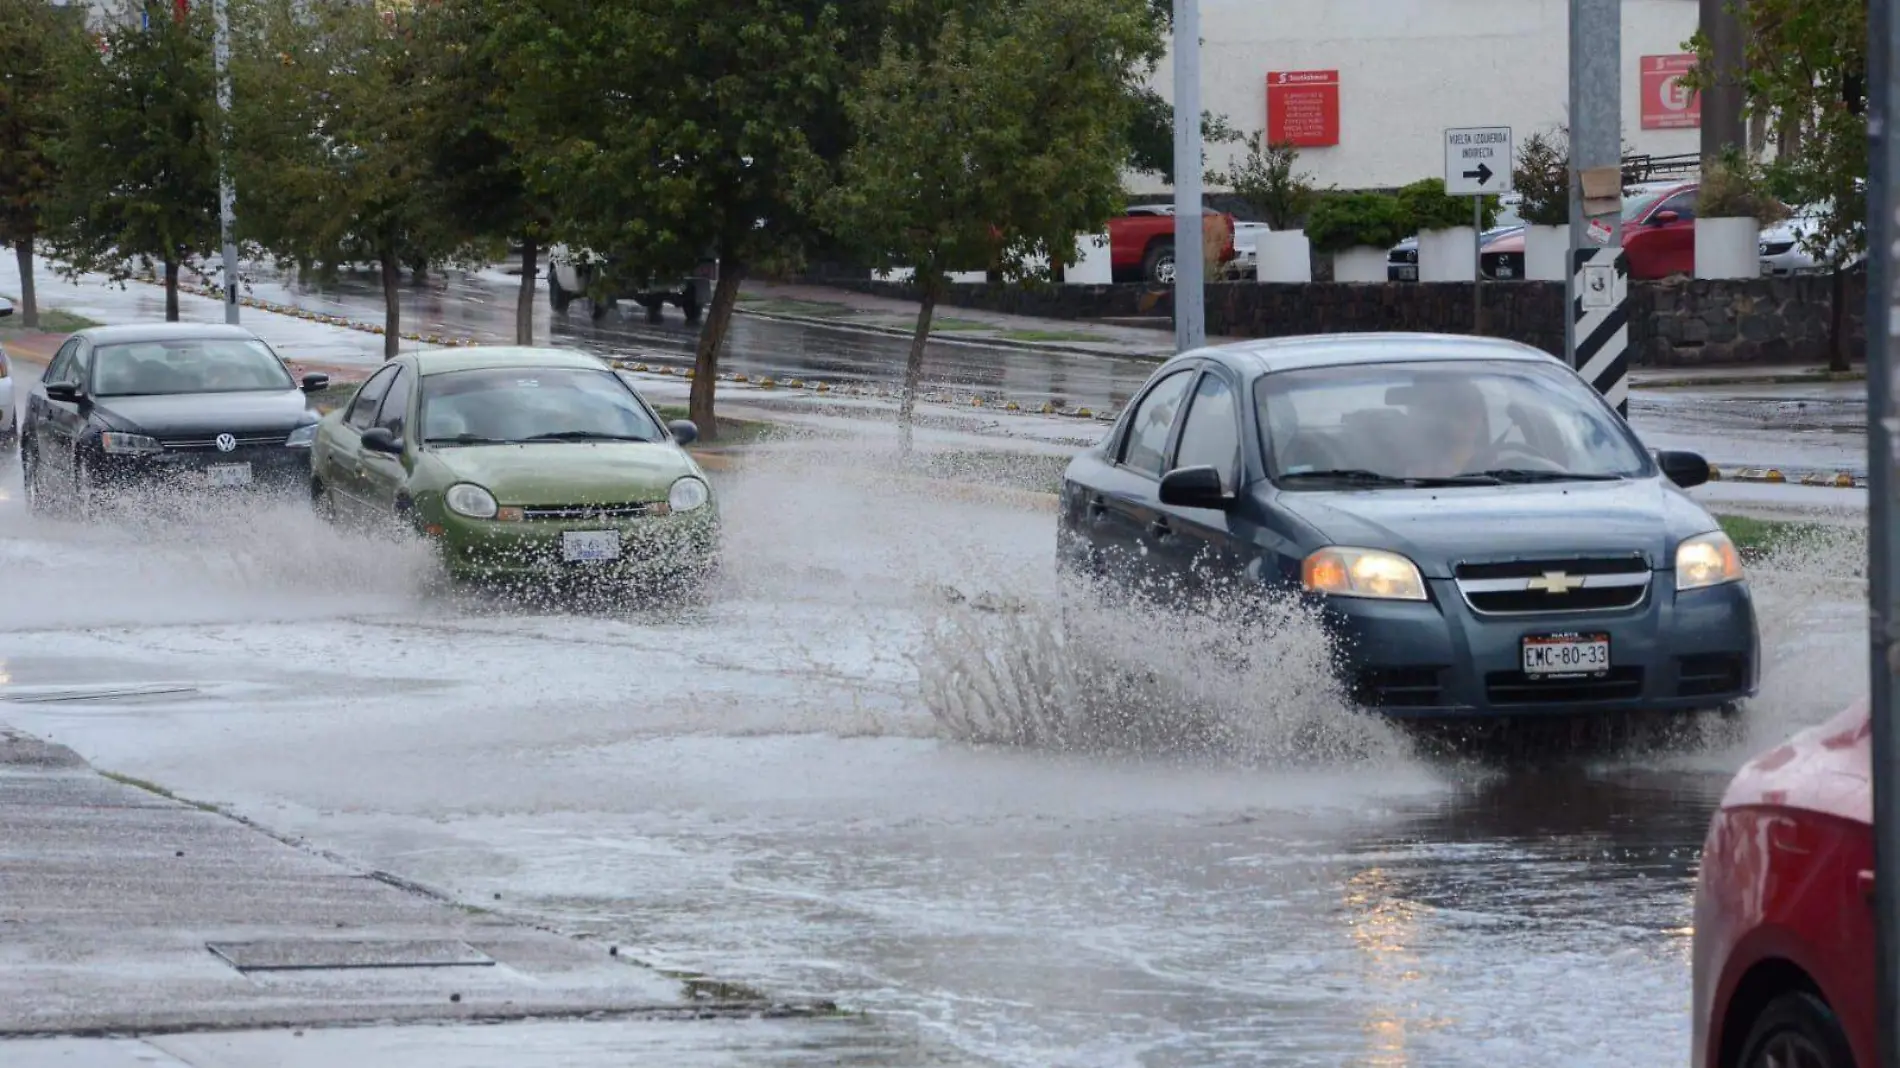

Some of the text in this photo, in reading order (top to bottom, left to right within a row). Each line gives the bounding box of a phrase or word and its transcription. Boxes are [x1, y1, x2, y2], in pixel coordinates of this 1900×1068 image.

[1449, 132, 1507, 145] VUELTA IZQUIERDA
[1462, 147, 1494, 158] INDIRECTA
[1525, 645, 1606, 667] EMC-80-33
